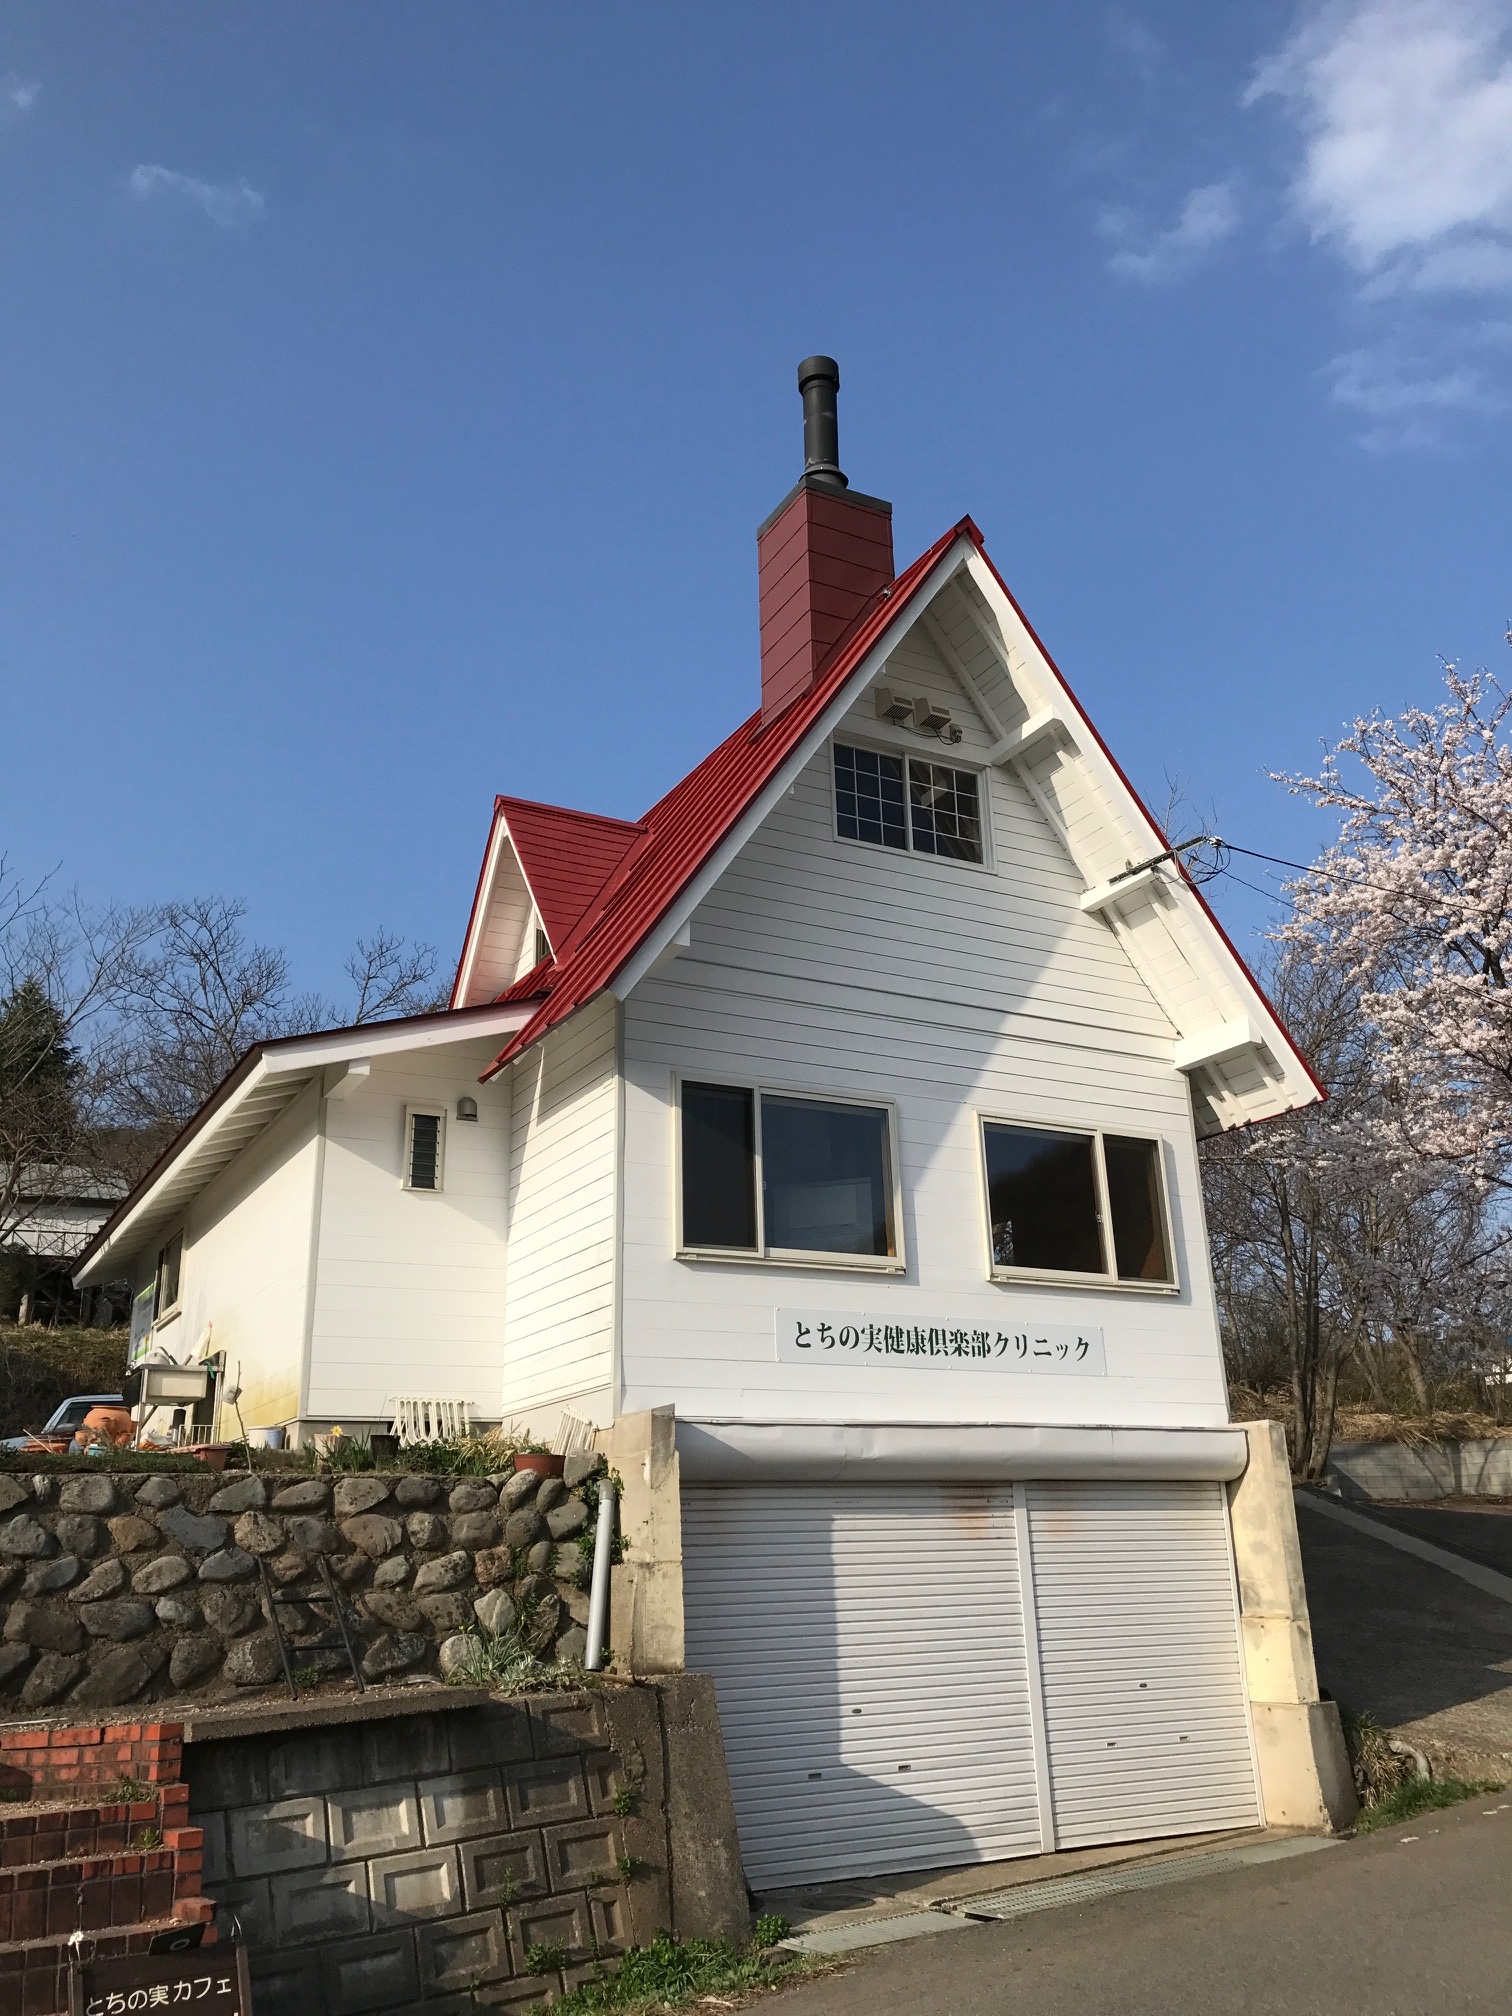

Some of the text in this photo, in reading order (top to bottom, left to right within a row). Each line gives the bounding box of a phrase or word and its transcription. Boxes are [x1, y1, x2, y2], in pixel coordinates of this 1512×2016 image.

[795, 1321, 1090, 1361] とちの実健康倶楽部クリニック
[86, 1977, 232, 2016] とちの実カフェ
